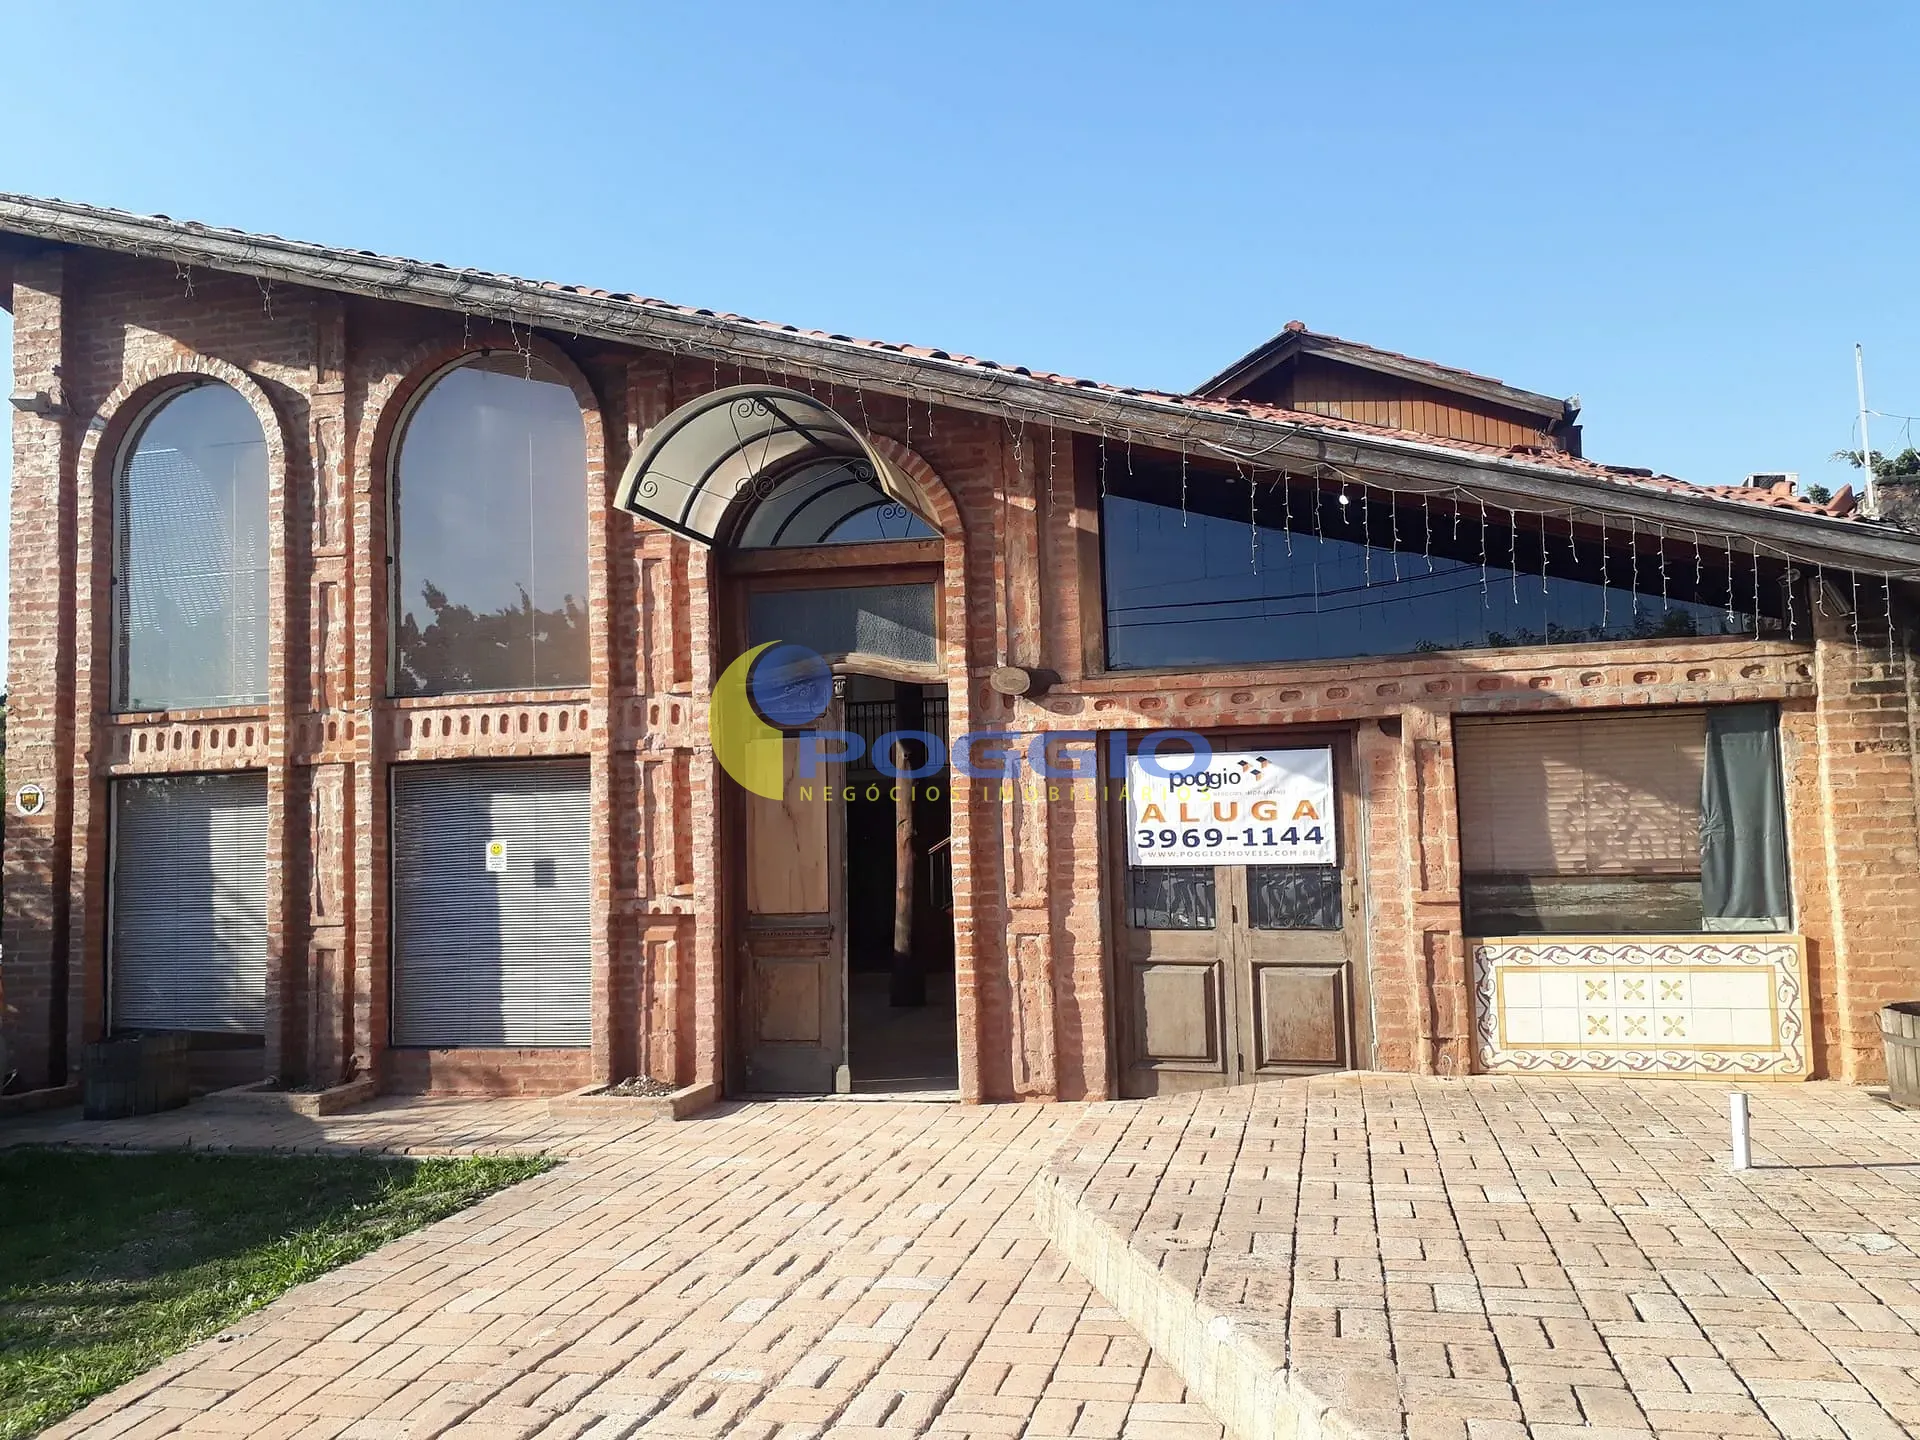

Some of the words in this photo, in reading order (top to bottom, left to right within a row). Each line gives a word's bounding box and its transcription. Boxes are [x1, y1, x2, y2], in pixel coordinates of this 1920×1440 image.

[1169, 768, 1241, 793] poggio
[1140, 800, 1320, 823] ALUGA
[1137, 826, 1324, 848] 3969-1144
